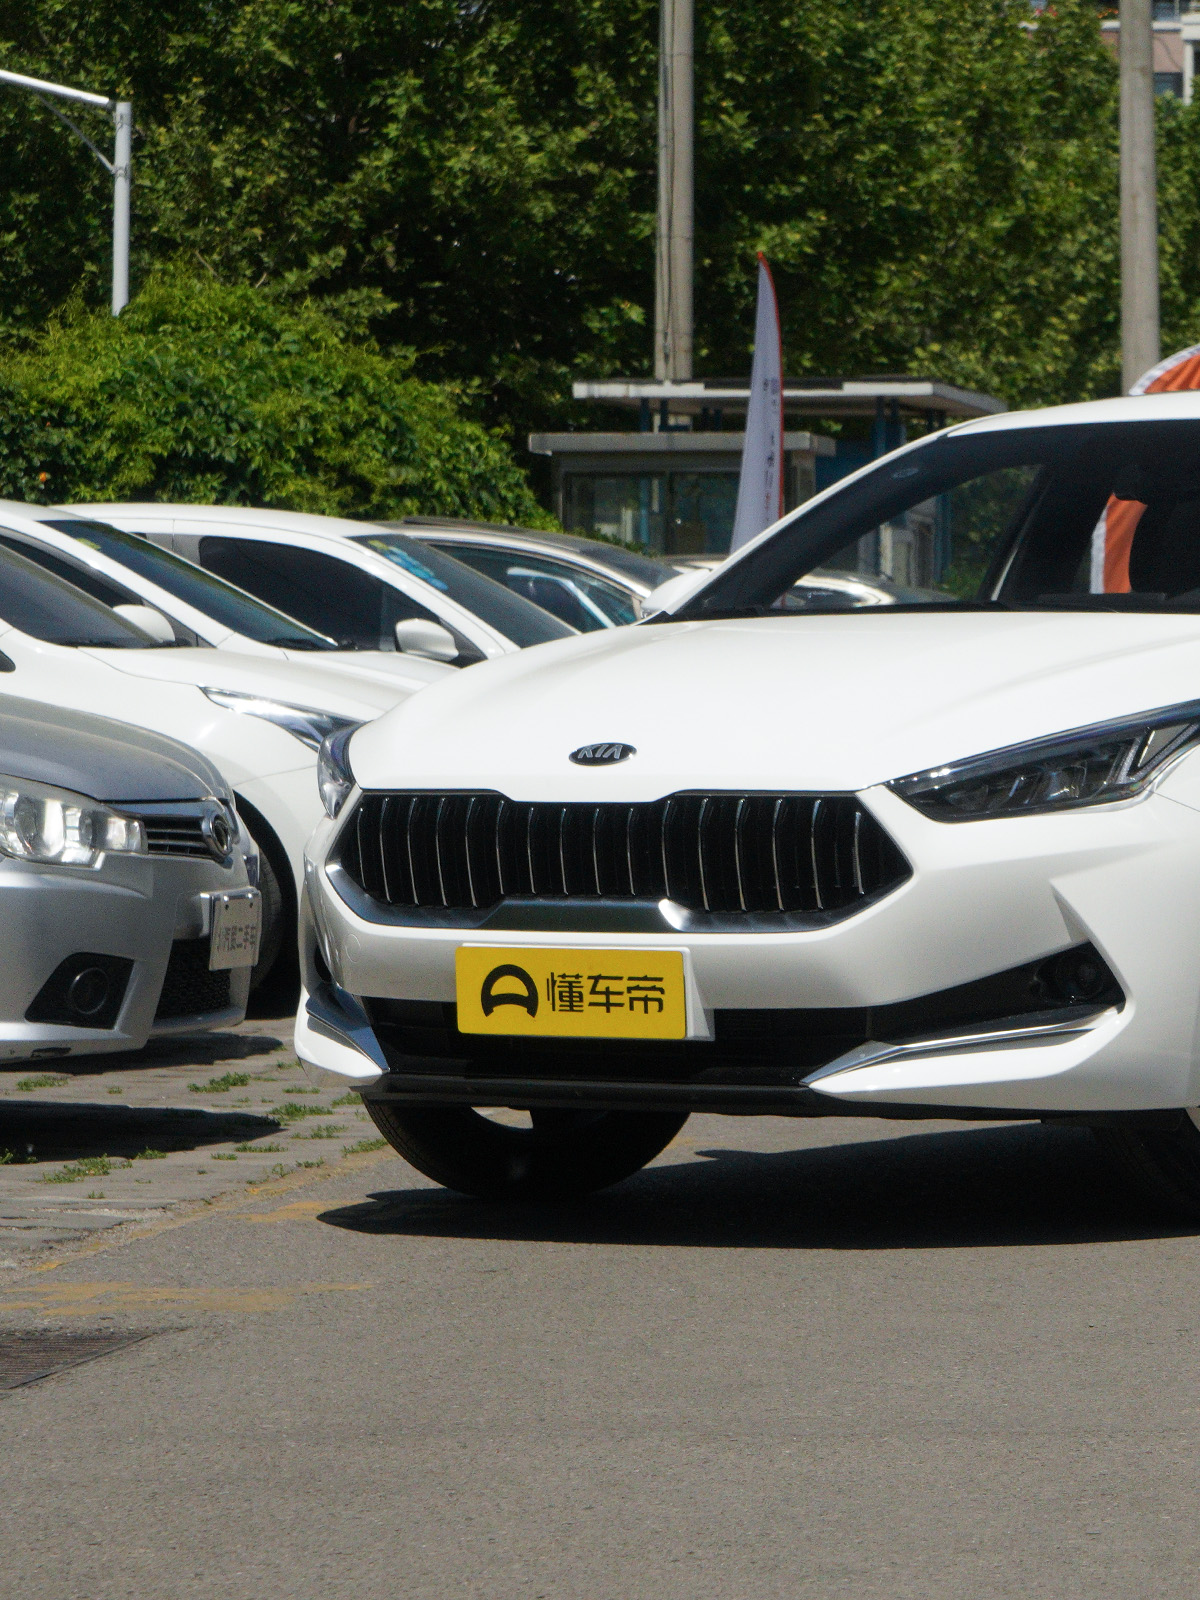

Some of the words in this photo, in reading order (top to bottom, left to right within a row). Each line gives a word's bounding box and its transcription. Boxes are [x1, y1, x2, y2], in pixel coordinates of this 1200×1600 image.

[577, 744, 623, 760] KIA
[546, 972, 665, 1014] 懂车帝
